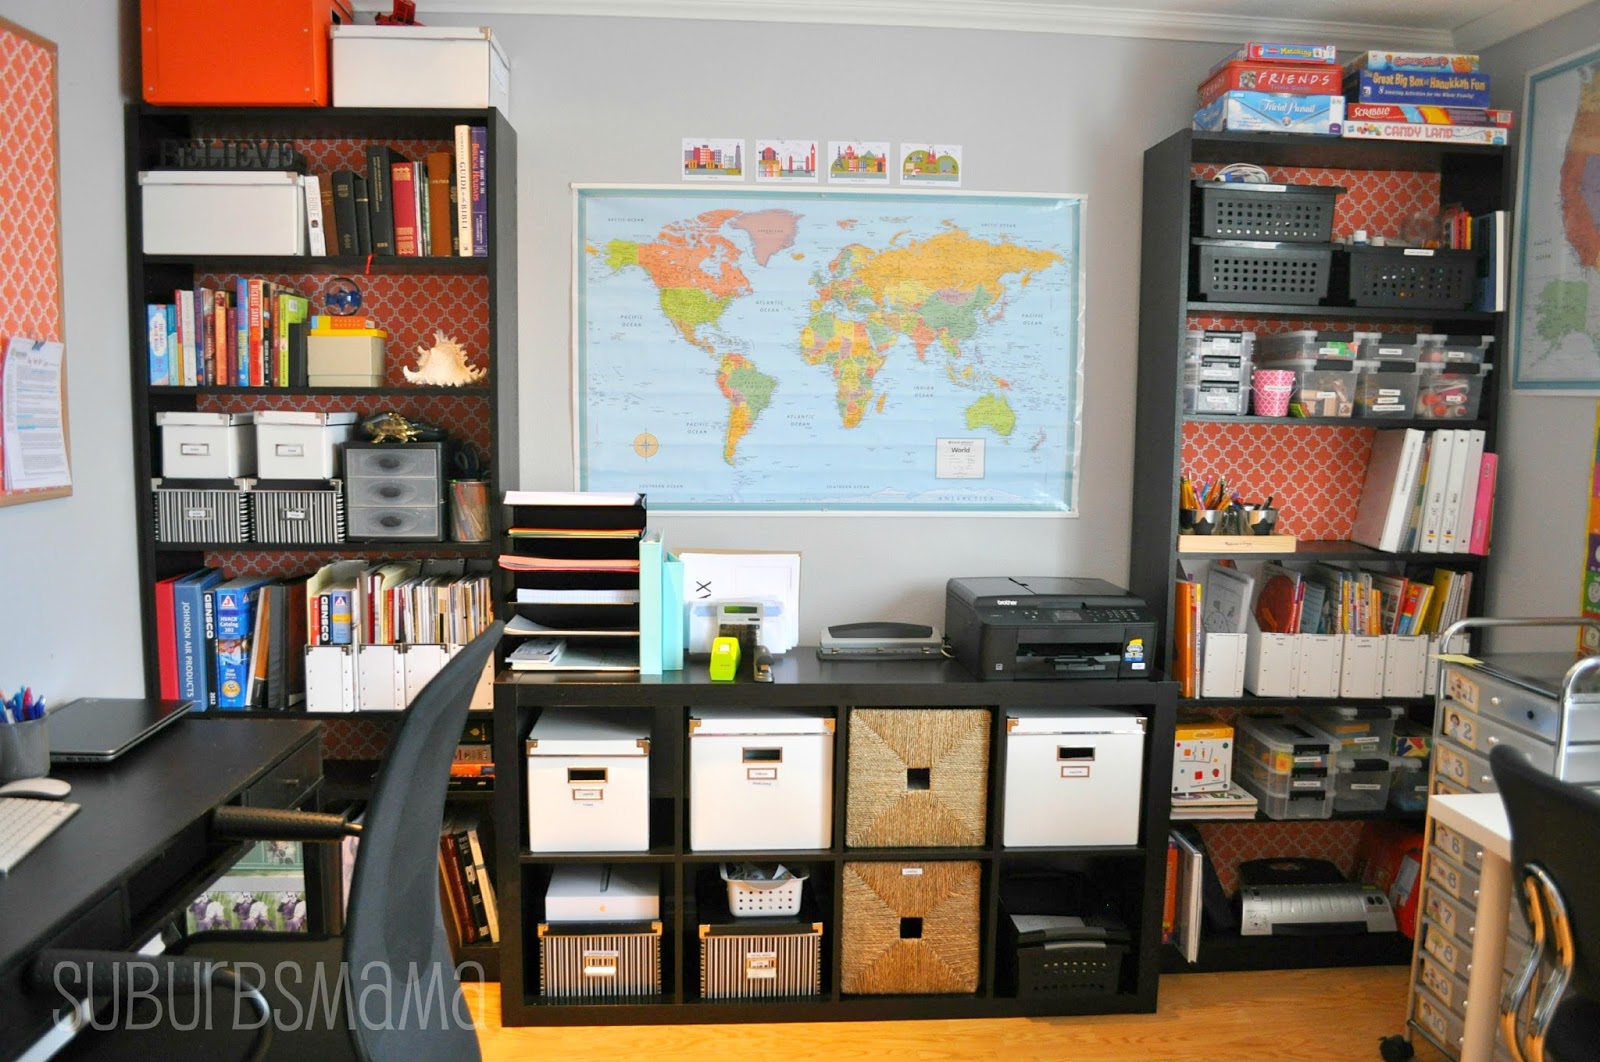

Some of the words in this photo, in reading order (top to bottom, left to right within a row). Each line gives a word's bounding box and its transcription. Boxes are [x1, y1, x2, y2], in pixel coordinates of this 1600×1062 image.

[1280, 48, 1312, 57] Matching
[1373, 72, 1394, 84] Great
[1395, 74, 1408, 88] Big
[1410, 76, 1424, 87] Box
[1430, 77, 1469, 90] Hanukkah
[1471, 78, 1486, 91] Fun
[1260, 98, 1286, 112] Trivial
[1286, 100, 1316, 114] Pursuit
[1384, 126, 1422, 138] CANDY
[1425, 127, 1454, 139] LAND
[251, 284, 259, 306] MICHAEL
[182, 602, 191, 638] JOHNSON
[204, 594, 214, 639] GENSCO
[321, 596, 329, 641] GENSCO
[186, 656, 194, 697] PRODUCTS
[1464, 723, 1472, 740] 2
[1455, 759, 1464, 777] 3
